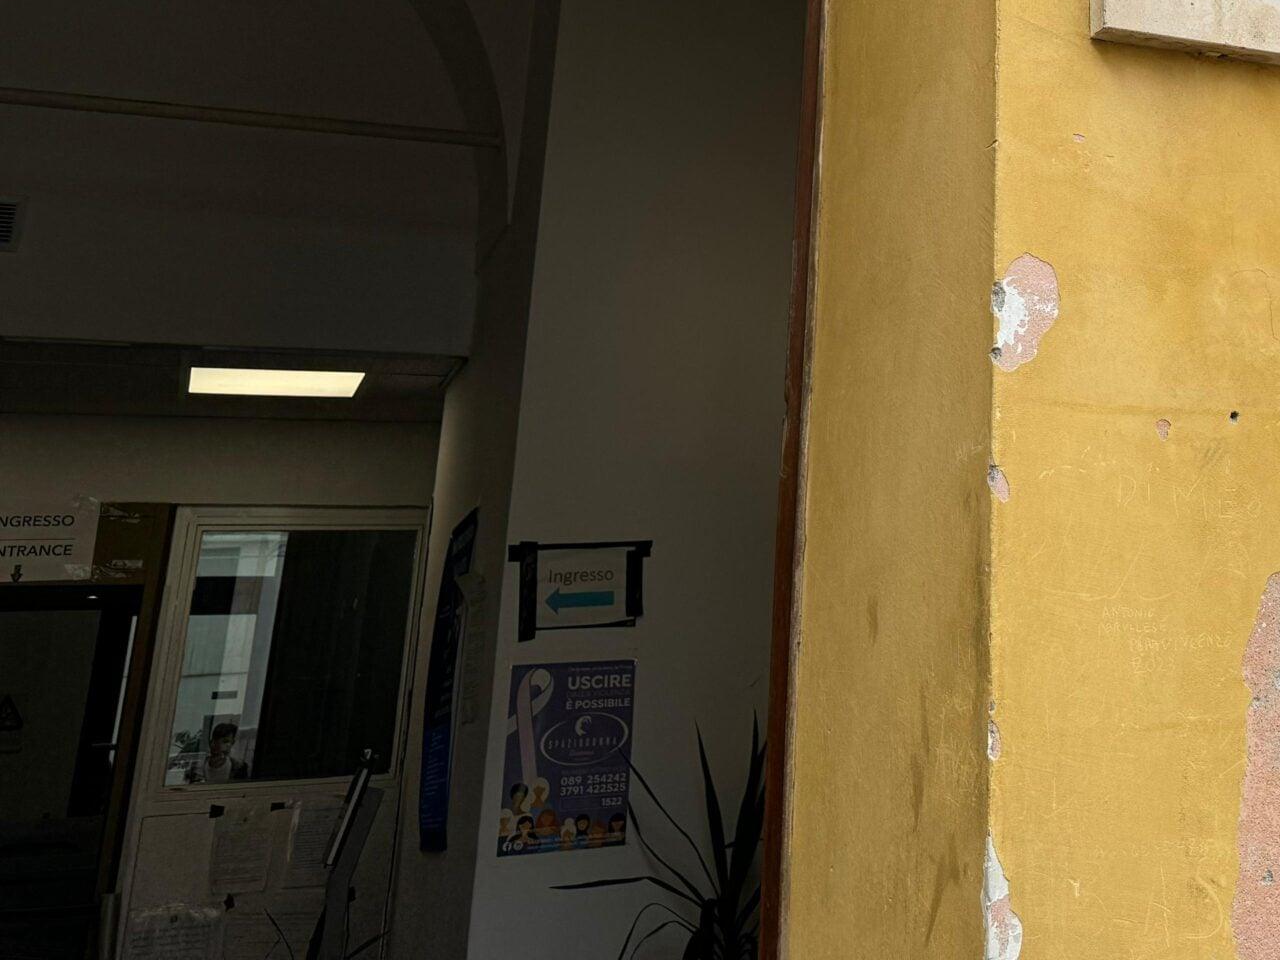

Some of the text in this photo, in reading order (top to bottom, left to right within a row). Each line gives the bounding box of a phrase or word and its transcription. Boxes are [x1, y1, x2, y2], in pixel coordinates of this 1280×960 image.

[548, 569, 614, 586] Ingresso
[567, 673, 632, 690] USCIRE
[575, 697, 631, 709] POSSIBILE
[560, 773, 626, 786] 089 254242
[560, 783, 626, 796] 3791 422525
[601, 797, 622, 807] 1522
